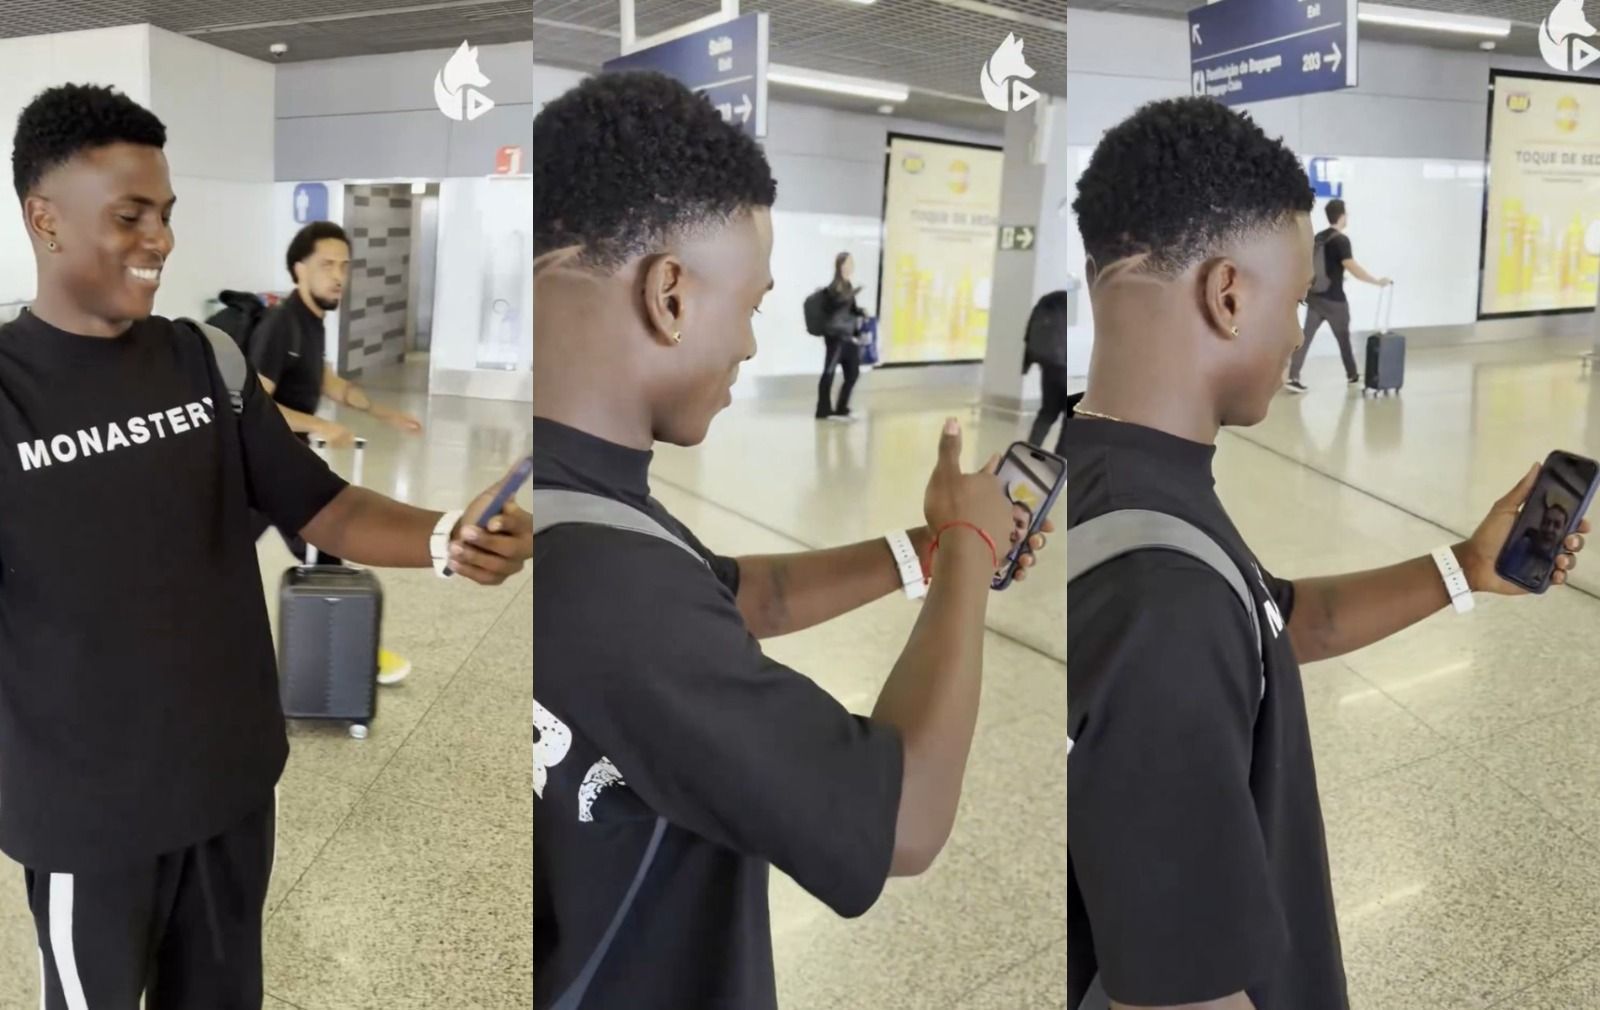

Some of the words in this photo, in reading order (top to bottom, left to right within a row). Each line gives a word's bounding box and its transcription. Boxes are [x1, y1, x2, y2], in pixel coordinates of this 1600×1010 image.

[1302, 51, 1321, 72] 203
[1516, 151, 1557, 166] TOQUE
[1562, 152, 1577, 165] DE
